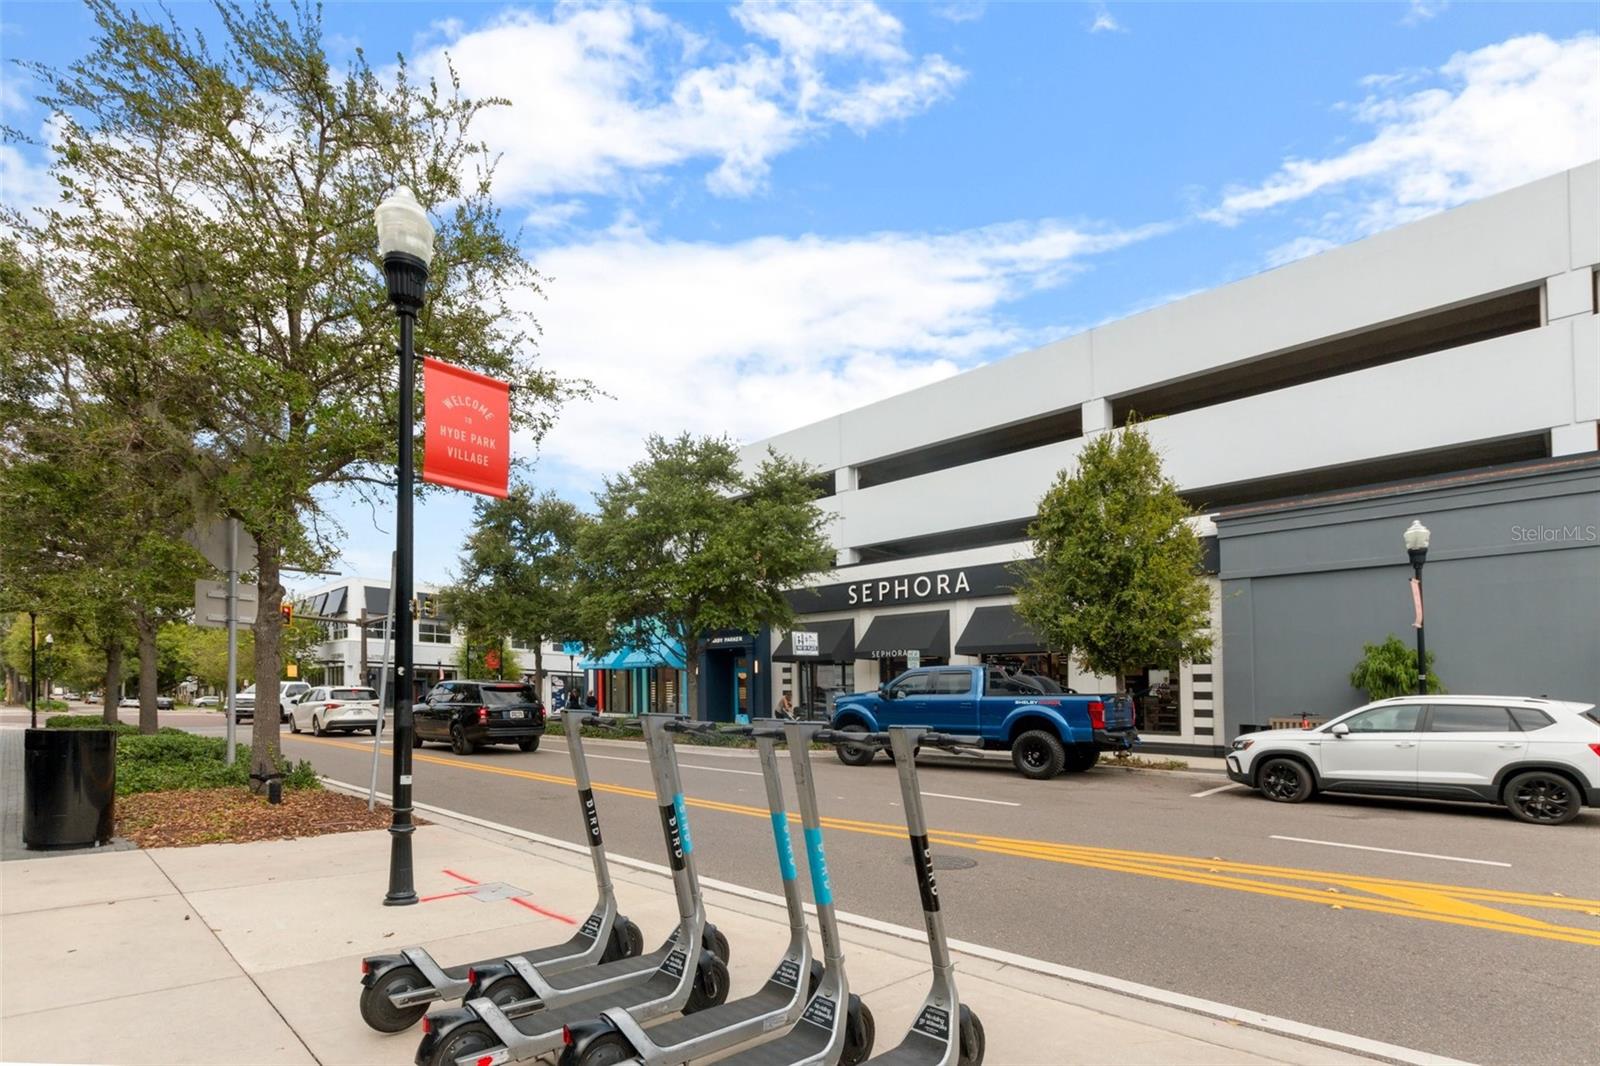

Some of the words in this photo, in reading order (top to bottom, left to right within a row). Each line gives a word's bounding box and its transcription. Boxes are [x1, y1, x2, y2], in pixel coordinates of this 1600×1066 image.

[442, 394, 495, 421] WELCOME
[464, 416, 472, 425] TO
[440, 425, 467, 441] HYDE
[470, 433, 496, 449] PARK
[447, 447, 489, 467] VILLAGE
[848, 571, 970, 605] SEPHORA
[871, 650, 908, 658] SEPHORA
[586, 799, 600, 836] BIRD
[669, 816, 683, 859] BIRD
